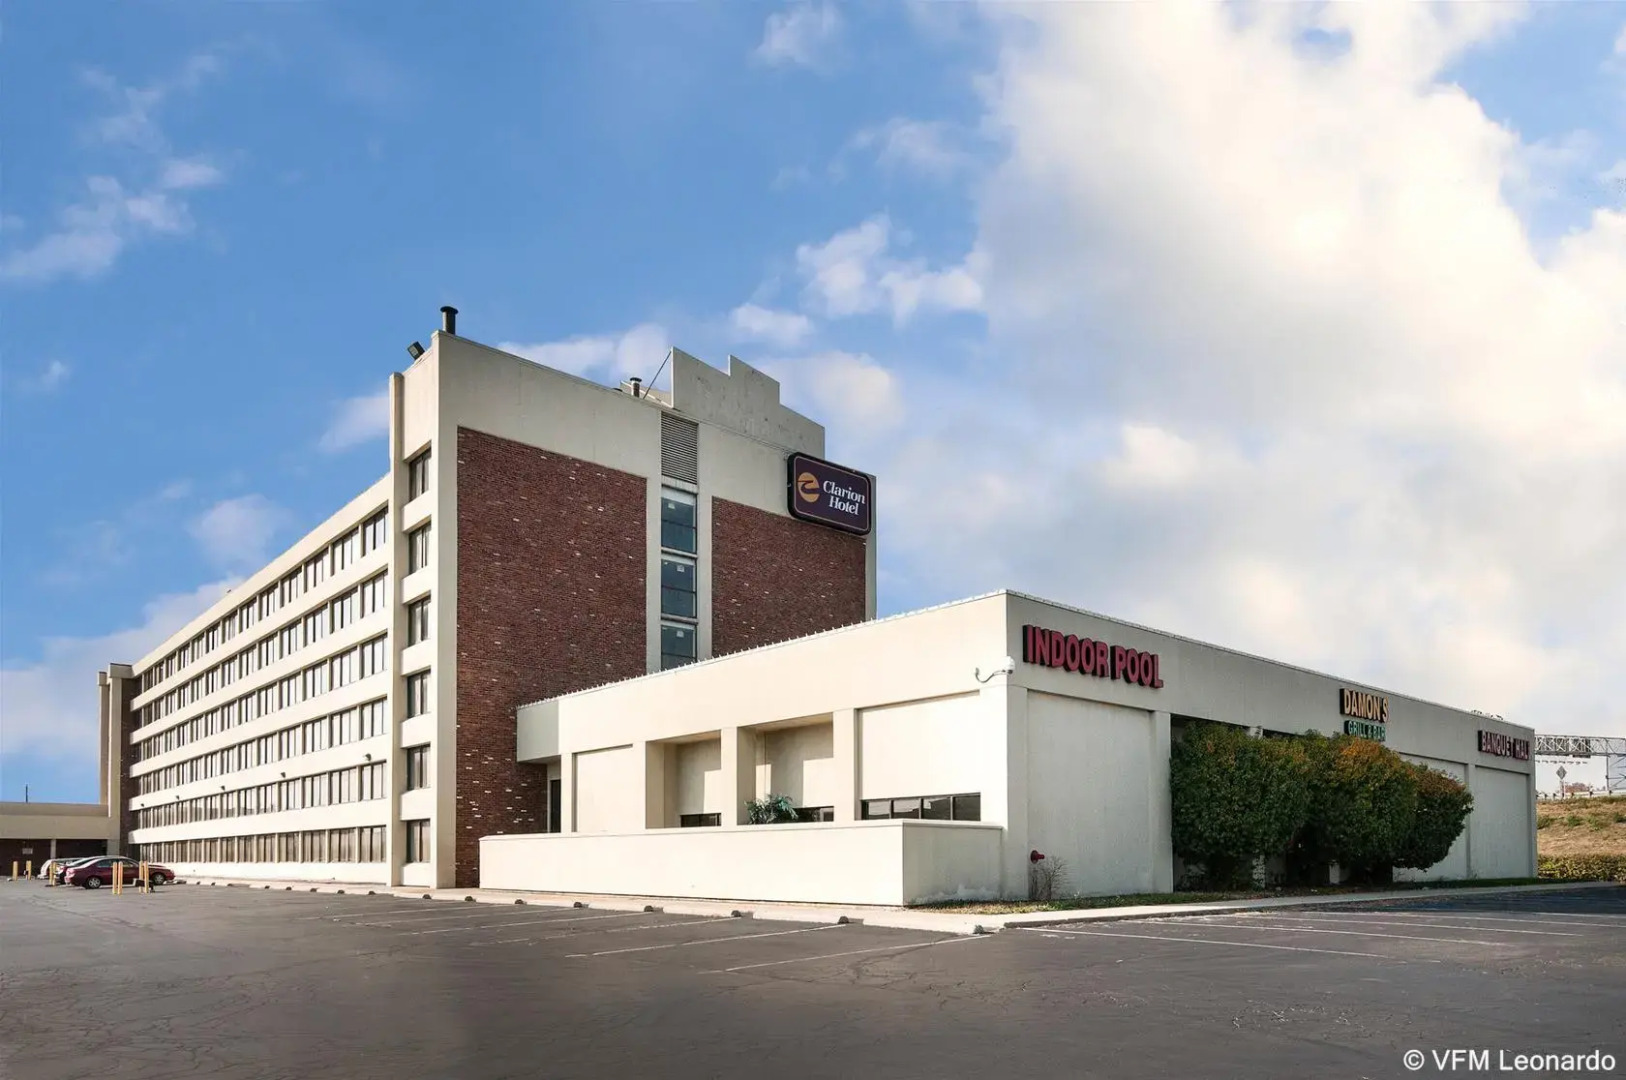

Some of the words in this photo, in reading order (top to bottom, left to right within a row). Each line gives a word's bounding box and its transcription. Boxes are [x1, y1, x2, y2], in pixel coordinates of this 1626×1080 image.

[823, 480, 866, 504] Clarion
[828, 495, 859, 515] Hotel
[1022, 624, 1109, 678] INDOOR
[1110, 645, 1164, 688] POOL
[1478, 730, 1514, 757] BANQUET
